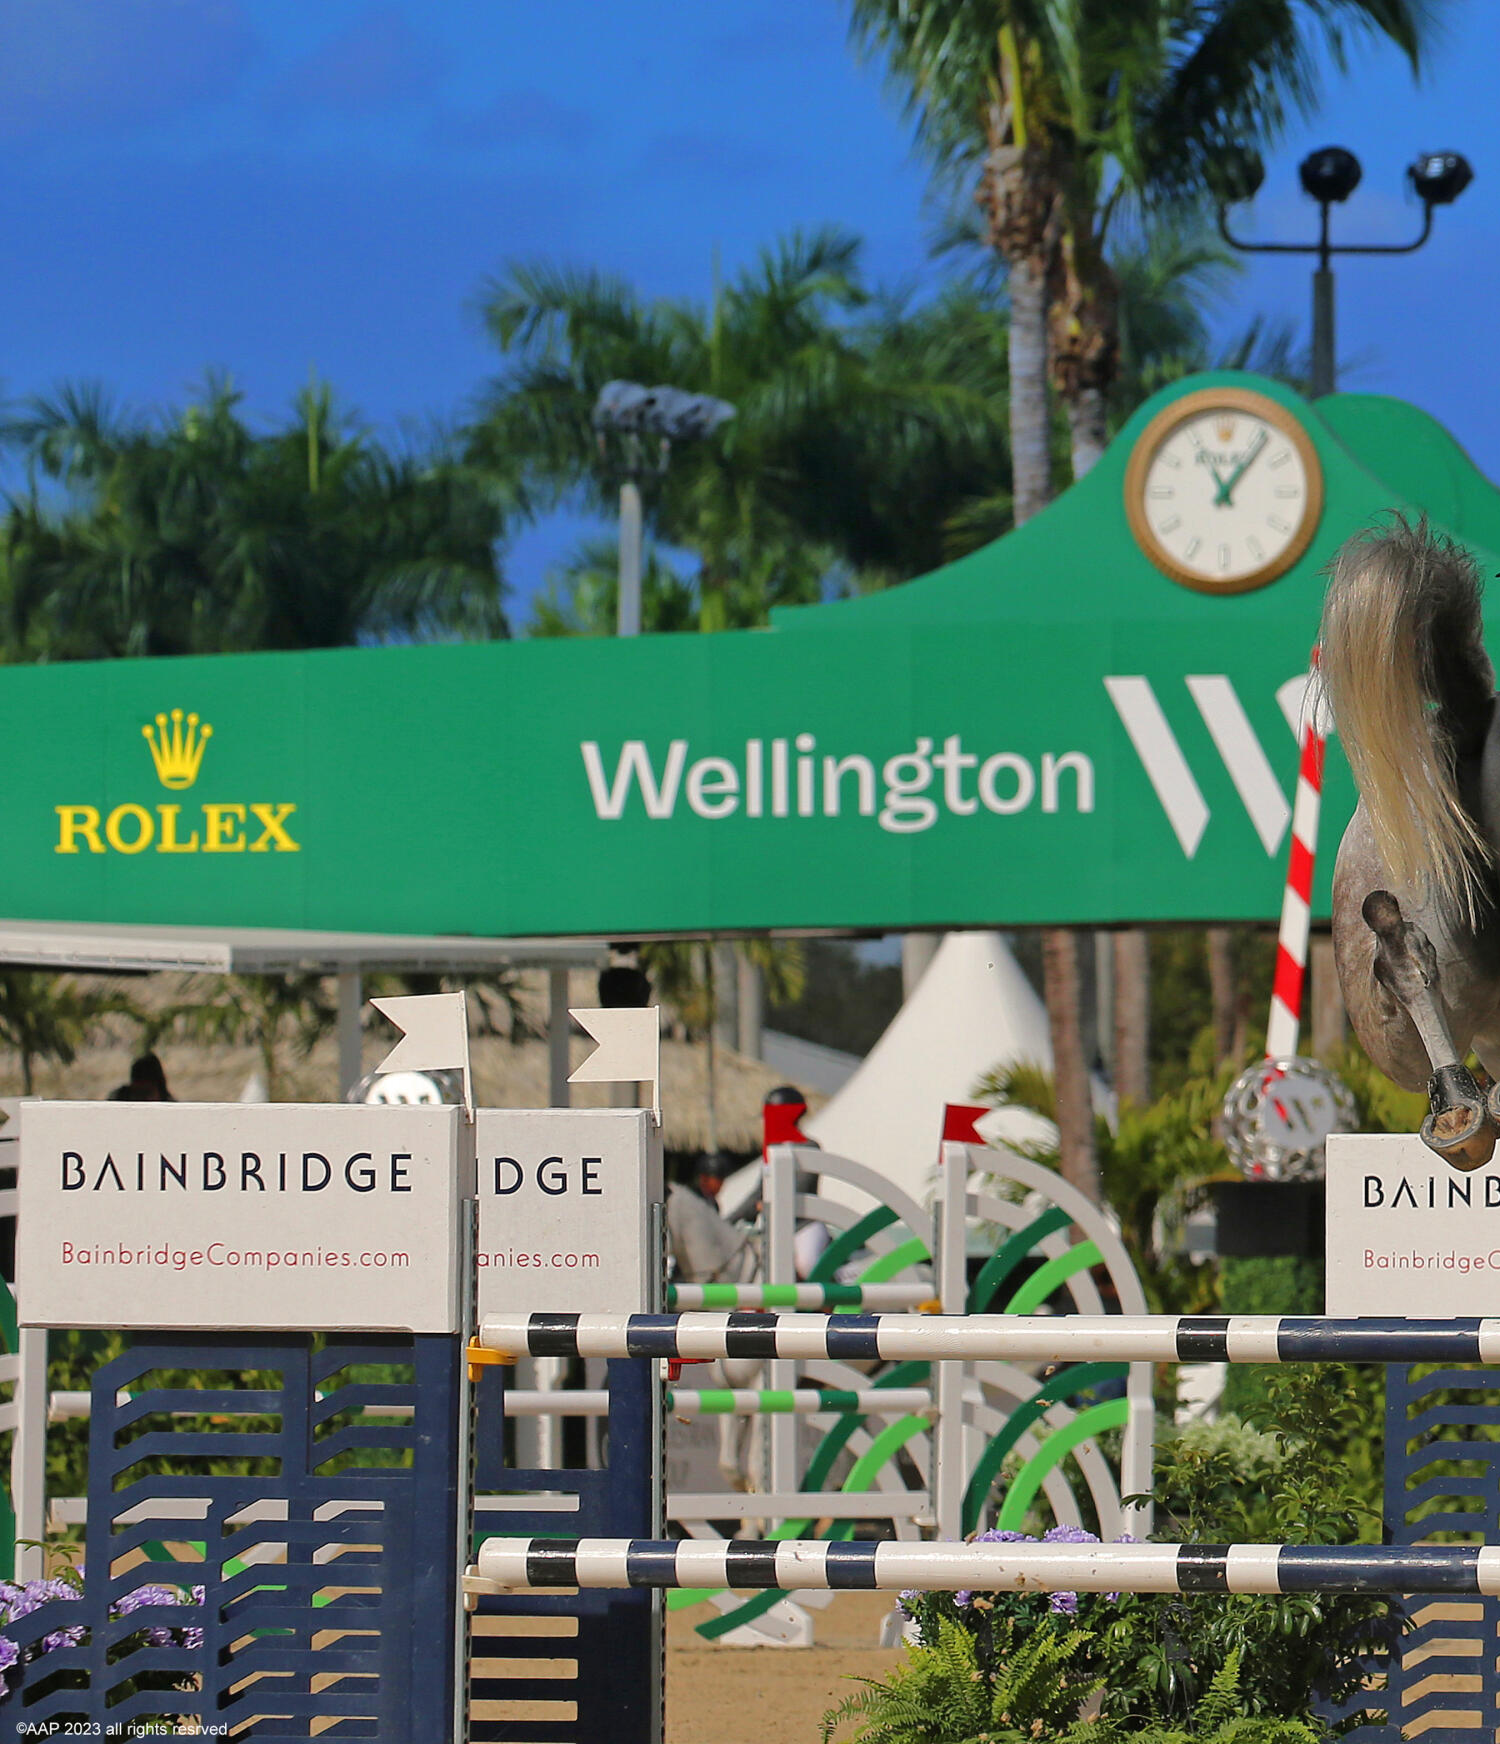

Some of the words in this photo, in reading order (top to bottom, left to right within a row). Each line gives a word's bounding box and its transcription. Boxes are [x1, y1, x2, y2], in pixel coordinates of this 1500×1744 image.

[580, 733, 1094, 834] Wellington
[55, 803, 300, 854] ROLEX
[62, 1151, 412, 1193] BAINBRIDGE
[61, 1241, 411, 1273] BainbridgeCompanies.com
